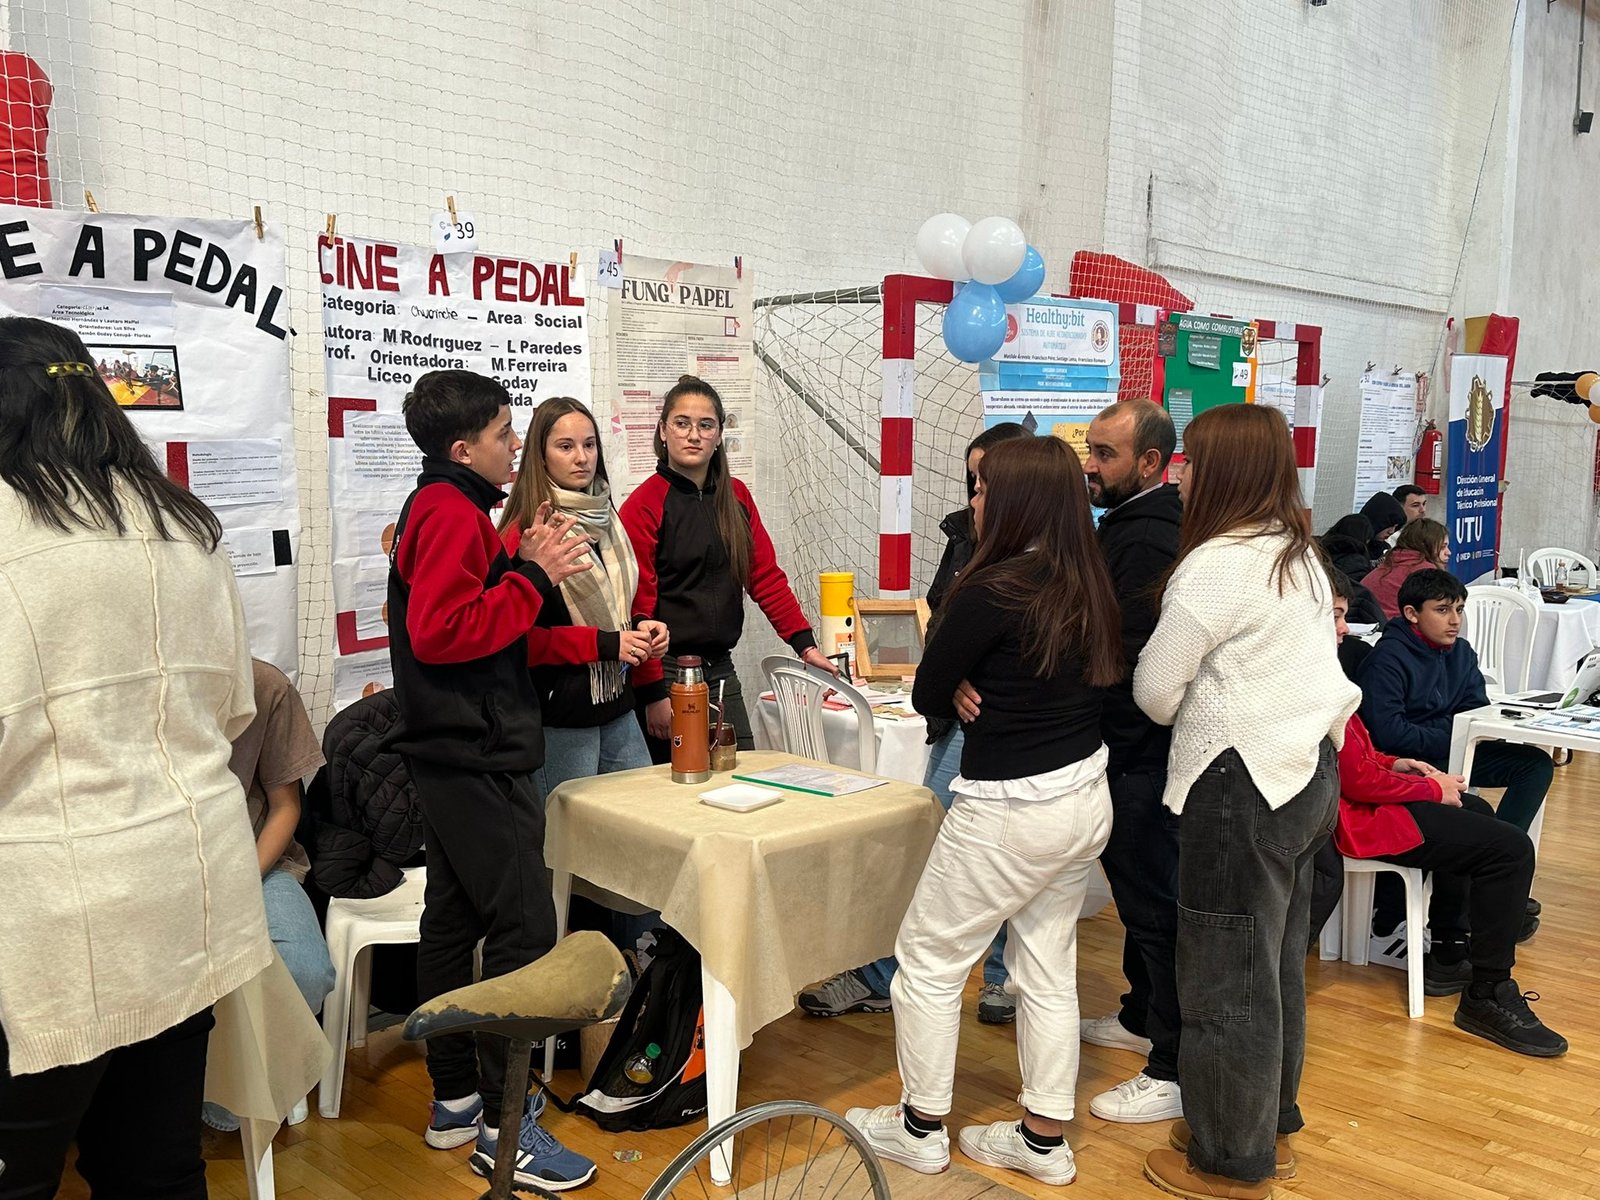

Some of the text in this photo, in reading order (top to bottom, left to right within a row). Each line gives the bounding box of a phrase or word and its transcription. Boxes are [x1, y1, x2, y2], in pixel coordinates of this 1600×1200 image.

[456, 221, 475, 240] 39
[68, 224, 105, 279] A
[607, 261, 619, 277] 45
[428, 254, 451, 297] A
[473, 256, 585, 307] PEDAL
[680, 285, 734, 308] PAPEL
[534, 313, 583, 329] Social
[1026, 307, 1086, 330] Healthy:bit
[1193, 320, 1210, 331] COMO
[1211, 322, 1244, 336] COMBUSTIBLE
[370, 349, 469, 370] Orientadora:
[367, 366, 412, 384] Liceo
[1240, 369, 1249, 381] 49
[1456, 515, 1483, 544] UTU
